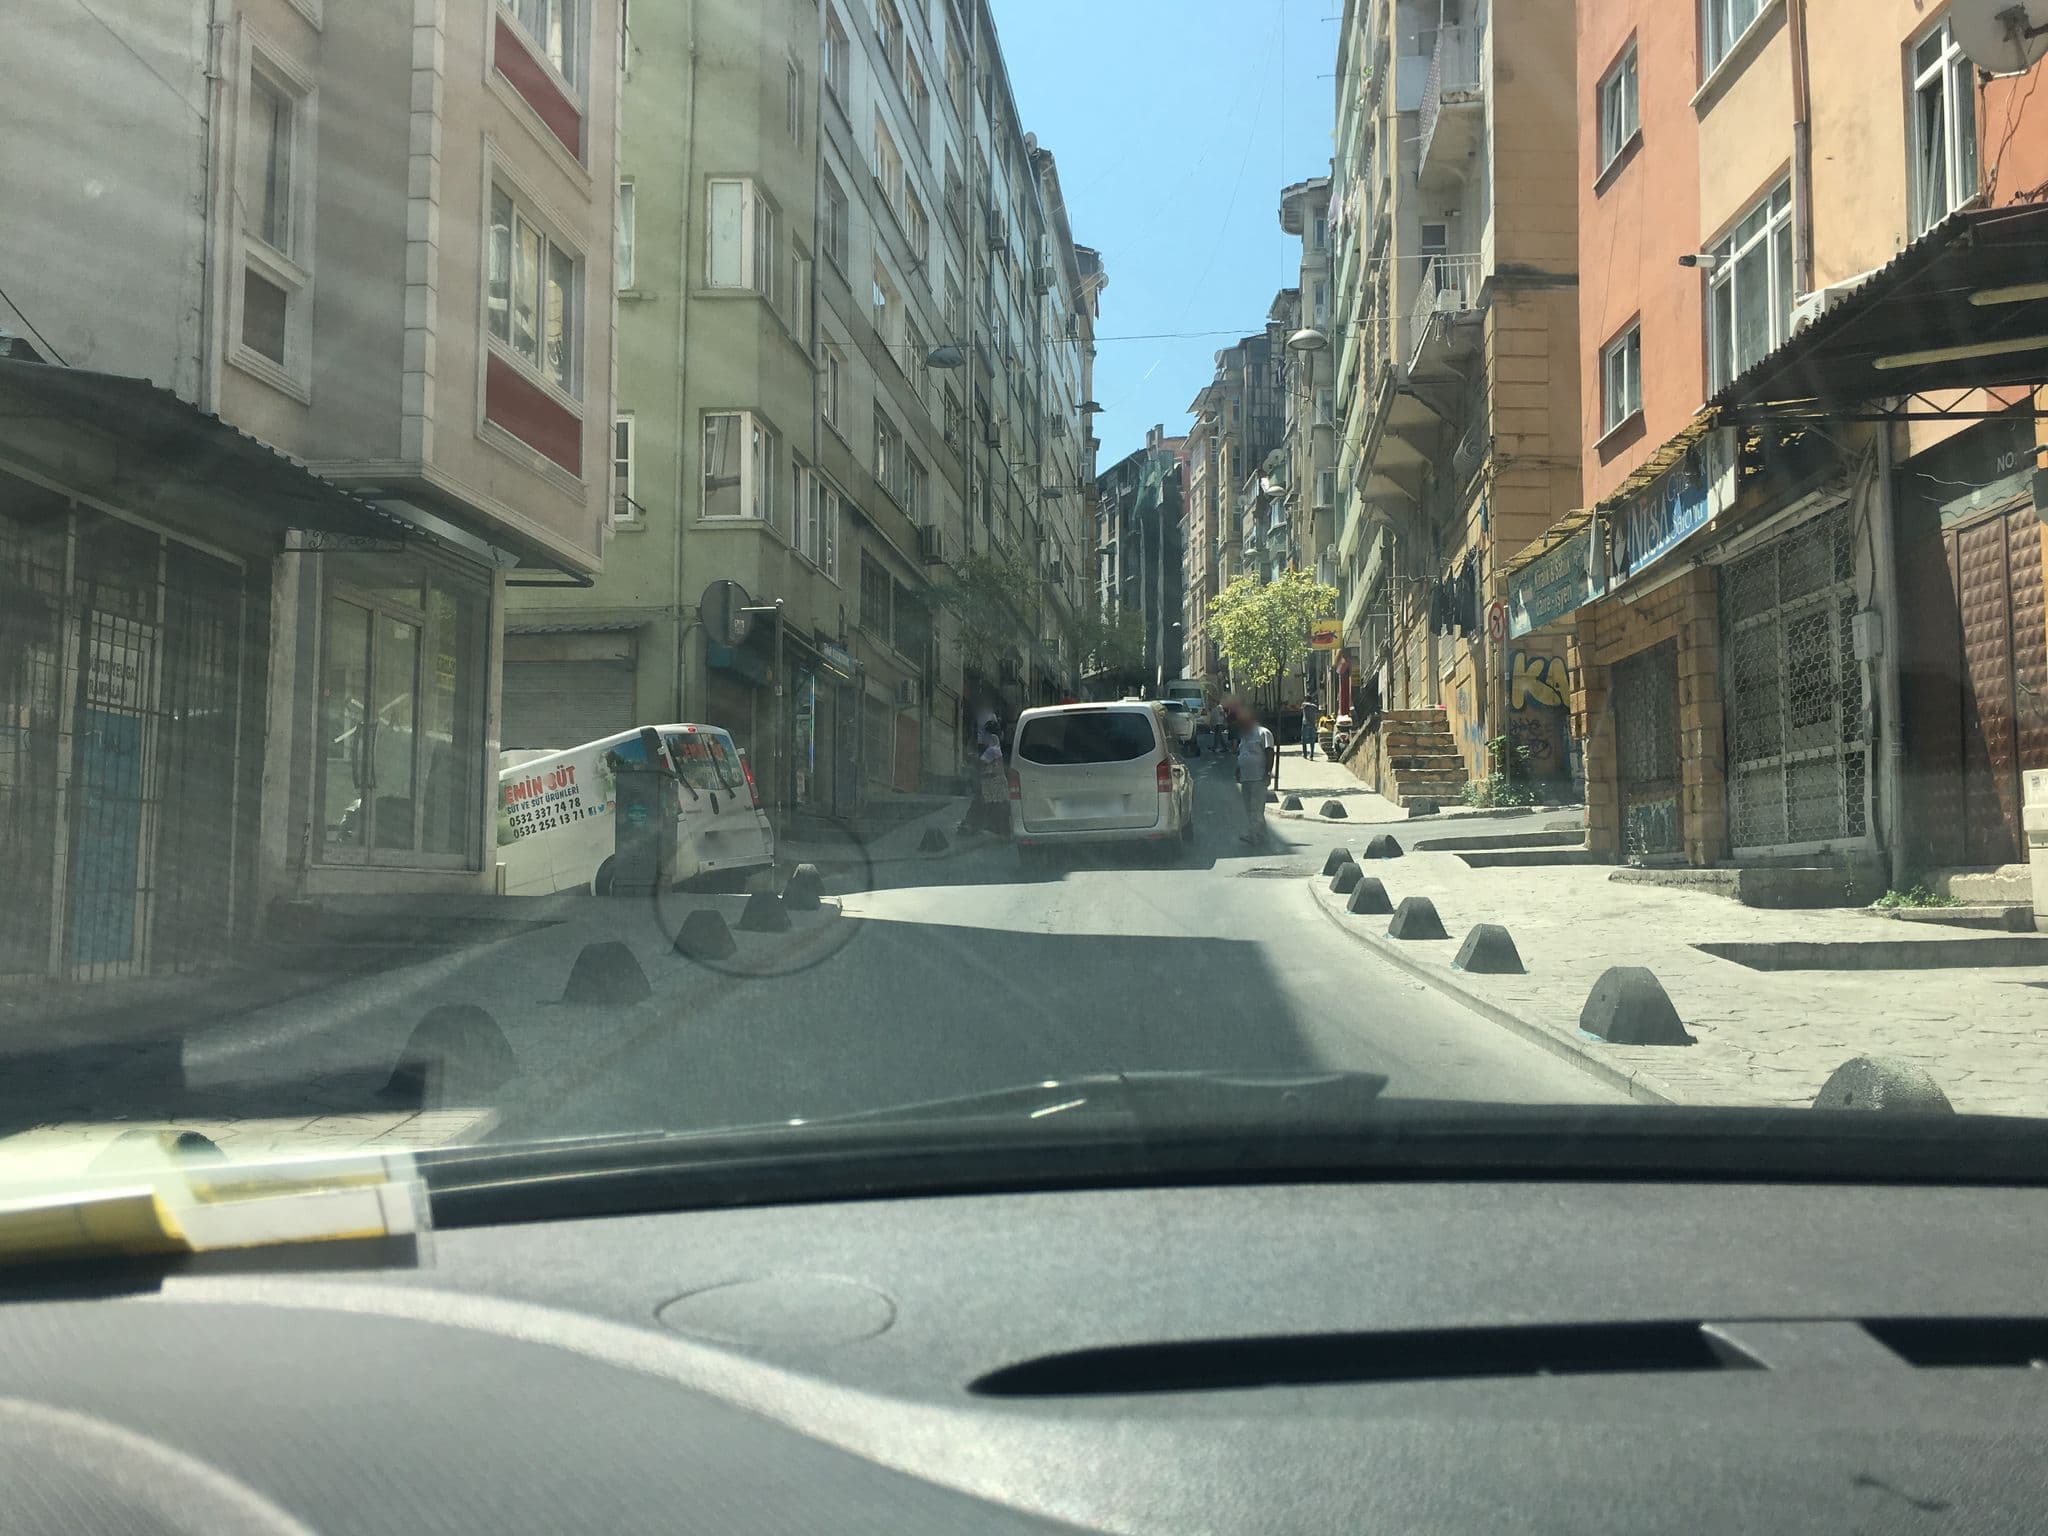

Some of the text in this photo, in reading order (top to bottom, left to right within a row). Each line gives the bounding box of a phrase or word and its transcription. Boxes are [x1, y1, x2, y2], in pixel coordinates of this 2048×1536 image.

[504, 775, 543, 805] EMİN
[509, 797, 581, 827] 0532 337 74 78
[521, 801, 529, 810] VE
[513, 824, 537, 839] 0532
[539, 818, 557, 831] 252
[560, 813, 571, 825] 13
[573, 809, 585, 821] 71
